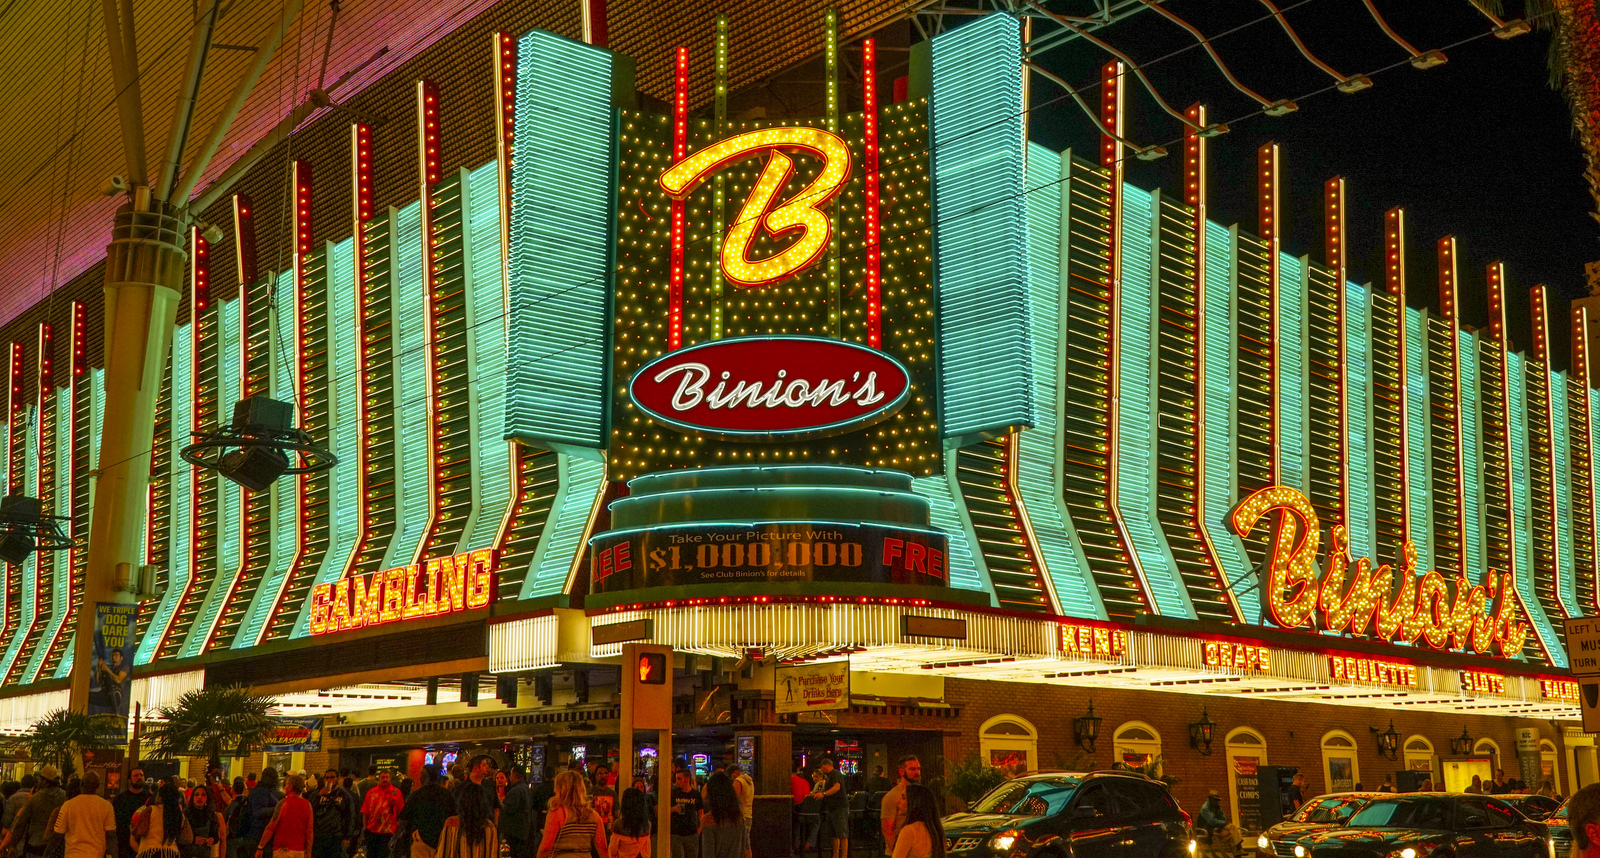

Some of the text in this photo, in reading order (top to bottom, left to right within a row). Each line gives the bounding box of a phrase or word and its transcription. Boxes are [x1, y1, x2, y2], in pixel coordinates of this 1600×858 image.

[659, 126, 853, 286] B
[654, 362, 885, 411] Binion's
[669, 530, 843, 544] Take Your Picture With
[592, 541, 632, 583] REE
[650, 542, 863, 572] $1,000,000
[701, 571, 715, 579] See
[735, 570, 765, 578] Binion's
[779, 569, 806, 577] details
[1232, 485, 1526, 658] Binion's
[309, 547, 492, 635] GAMBLING
[99, 605, 136, 615] WE TRIPLE
[105, 613, 128, 625] DOG
[102, 625, 129, 637] DARE
[1569, 624, 1590, 635] LEFT
[103, 636, 125, 648] YOU
[1062, 624, 1127, 657] KENO
[1205, 640, 1270, 672] CRAPS
[1573, 657, 1597, 668] TURN
[1332, 656, 1417, 688] ROULETTE
[798, 673, 845, 686] Purchase Your
[1464, 670, 1505, 693] SLOTS
[803, 686, 842, 699] Drinks Here
[1544, 680, 1580, 700] SALOO
[1240, 791, 1260, 799] COMPS
